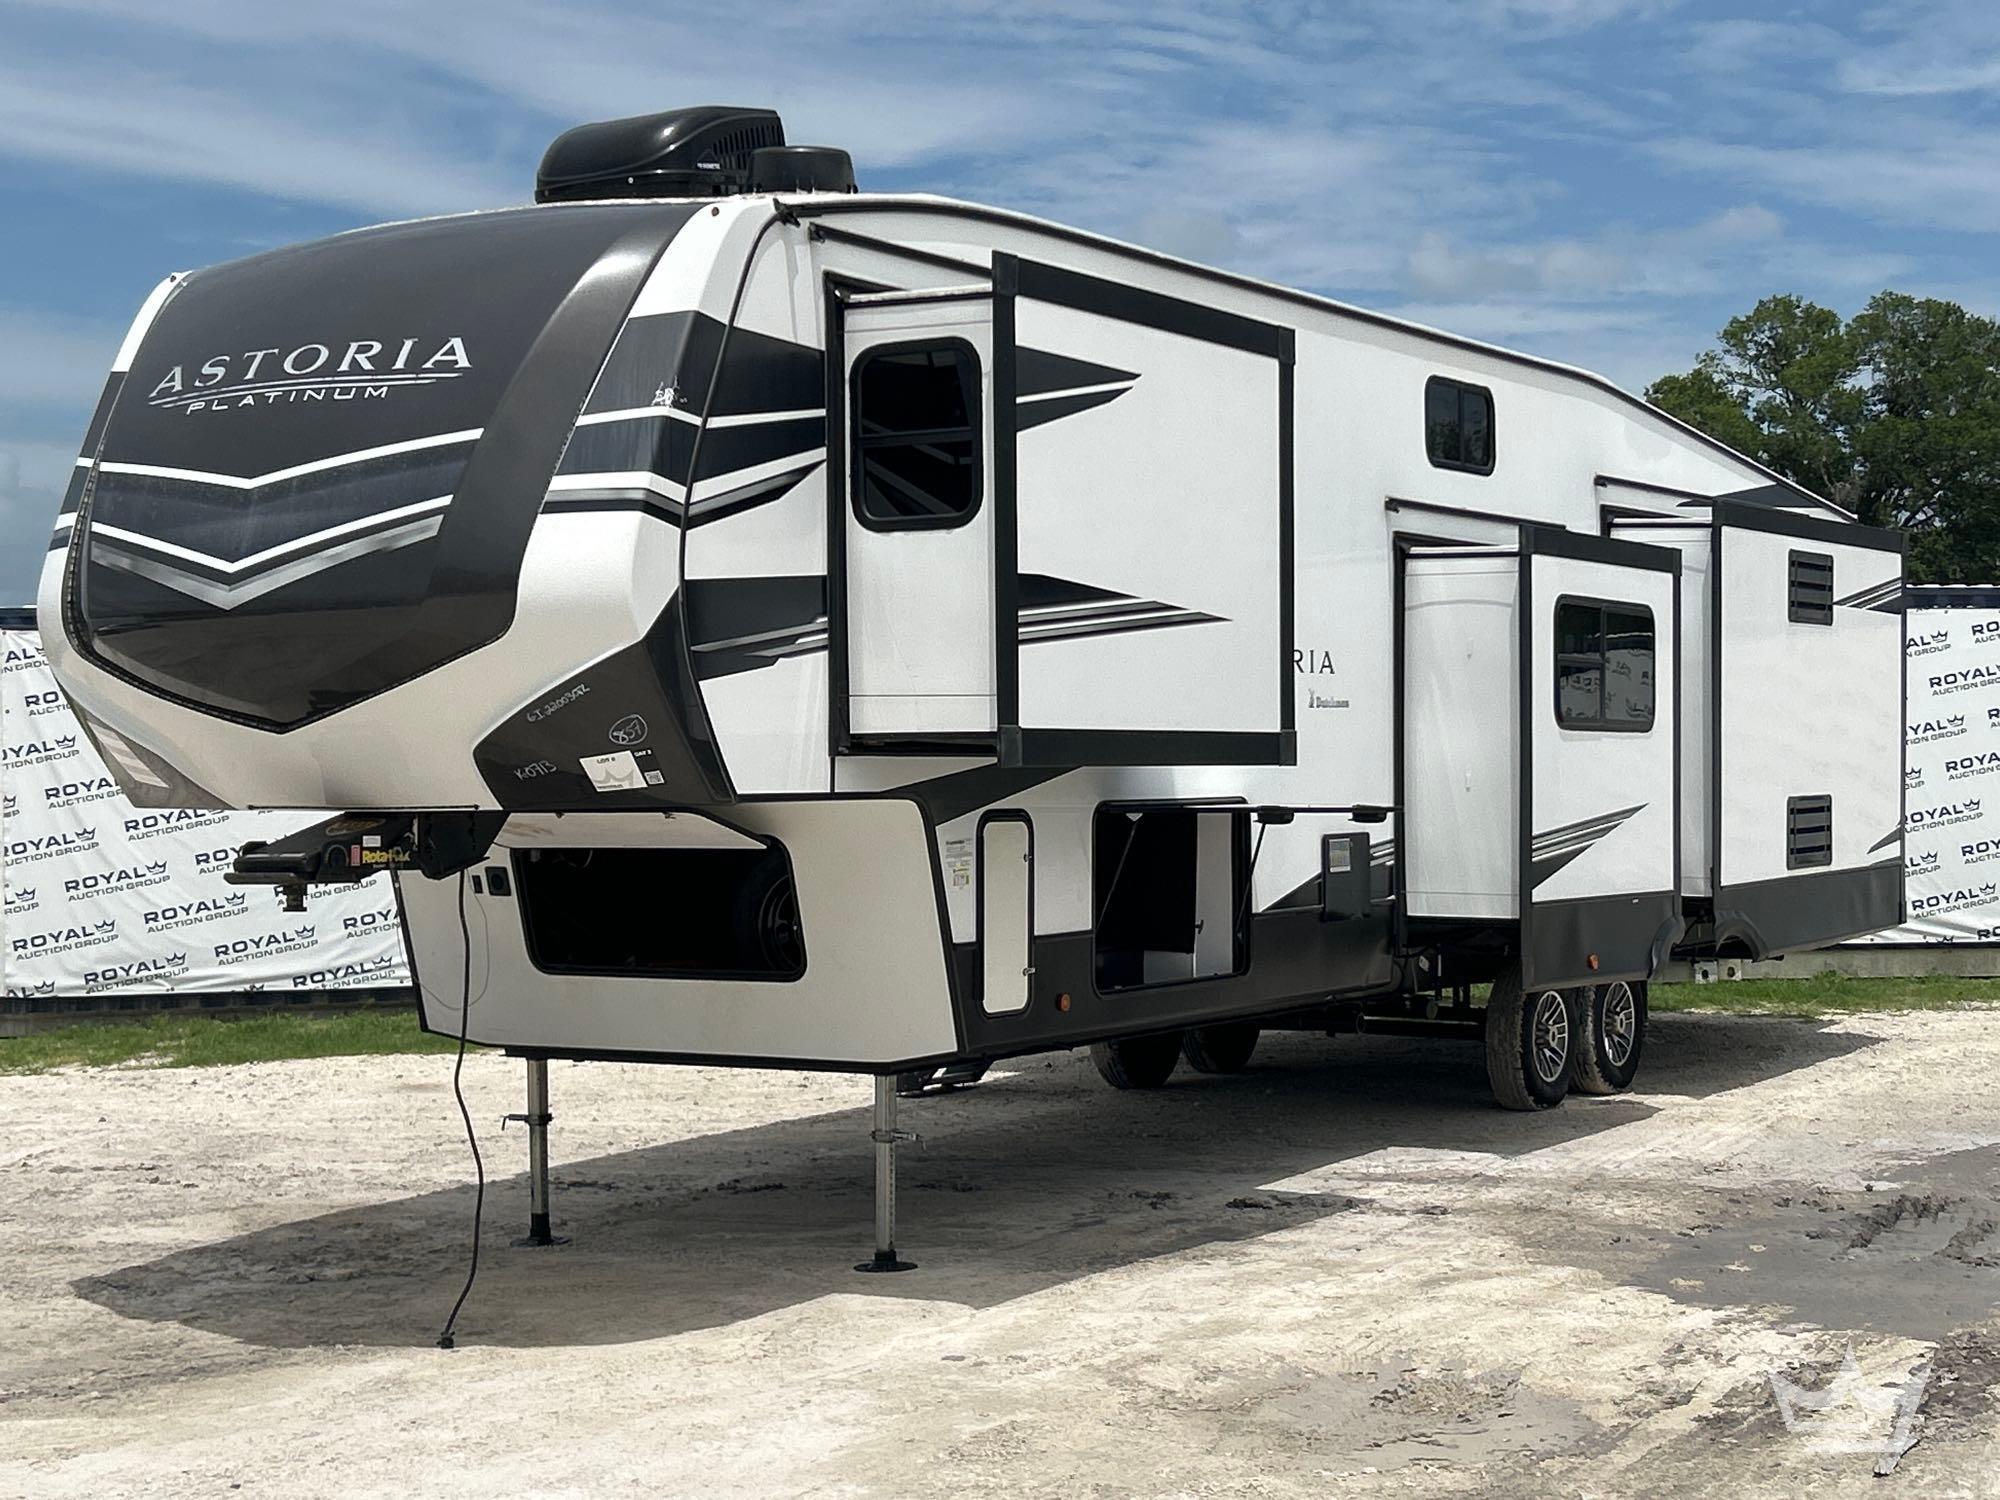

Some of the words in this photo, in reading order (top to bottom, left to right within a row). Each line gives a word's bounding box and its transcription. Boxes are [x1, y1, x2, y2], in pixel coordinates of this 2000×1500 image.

[148, 336, 473, 398] ASTORIA
[186, 386, 389, 415] PLATINUM
[1914, 643, 1952, 657] GROUP
[1929, 666, 1997, 688] ROYAL
[1932, 681, 1978, 697] AUCTION
[29, 704, 71, 716] AUCTIO
[1905, 736, 1930, 746] TION
[1930, 727, 1968, 741] GROUP
[1906, 720, 1948, 737] YAL
[2, 741, 56, 761] YAL
[2, 758, 34, 770] TION
[35, 749, 80, 764] GROUP
[1945, 751, 2000, 772] ROYA
[1948, 766, 1995, 781] AUCTION
[48, 792, 105, 809] AUCTION
[124, 809, 206, 832] ROYAL
[128, 825, 184, 842] AUCTION
[185, 815, 230, 830] GROUP
[1905, 820, 1945, 834] UCTION
[1946, 812, 1984, 825] GROUP
[5, 850, 53, 867] UCTION
[55, 841, 100, 856] GROUP
[194, 847, 242, 866] ROY
[1961, 839, 2000, 856] ROY
[199, 862, 232, 875] AUCT
[64, 867, 146, 893] ROYAL
[68, 884, 124, 902] AUCTION
[126, 875, 171, 890] GROUP
[333, 879, 377, 894] GROUP
[4, 902, 40, 915] ROUP
[1911, 889, 1979, 911] ROYAL
[1914, 904, 1961, 919] AUCTION
[1962, 896, 1999, 909] GROUP
[143, 899, 226, 925] ROYAL
[147, 917, 203, 933] AUCTION
[205, 906, 249, 922] GROUP
[13, 926, 95, 951] ROYAL
[16, 944, 73, 961] AUCTION
[75, 934, 119, 949] GROUP
[214, 931, 296, 957] ROYAL
[218, 949, 273, 966] AUCTION
[275, 939, 319, 954] GROUP
[84, 959, 166, 985] ROYAL
[87, 976, 144, 994] AUCTION
[145, 967, 190, 982] GROUP
[292, 962, 371, 988] ROYAL
[353, 969, 396, 985] GROUP
